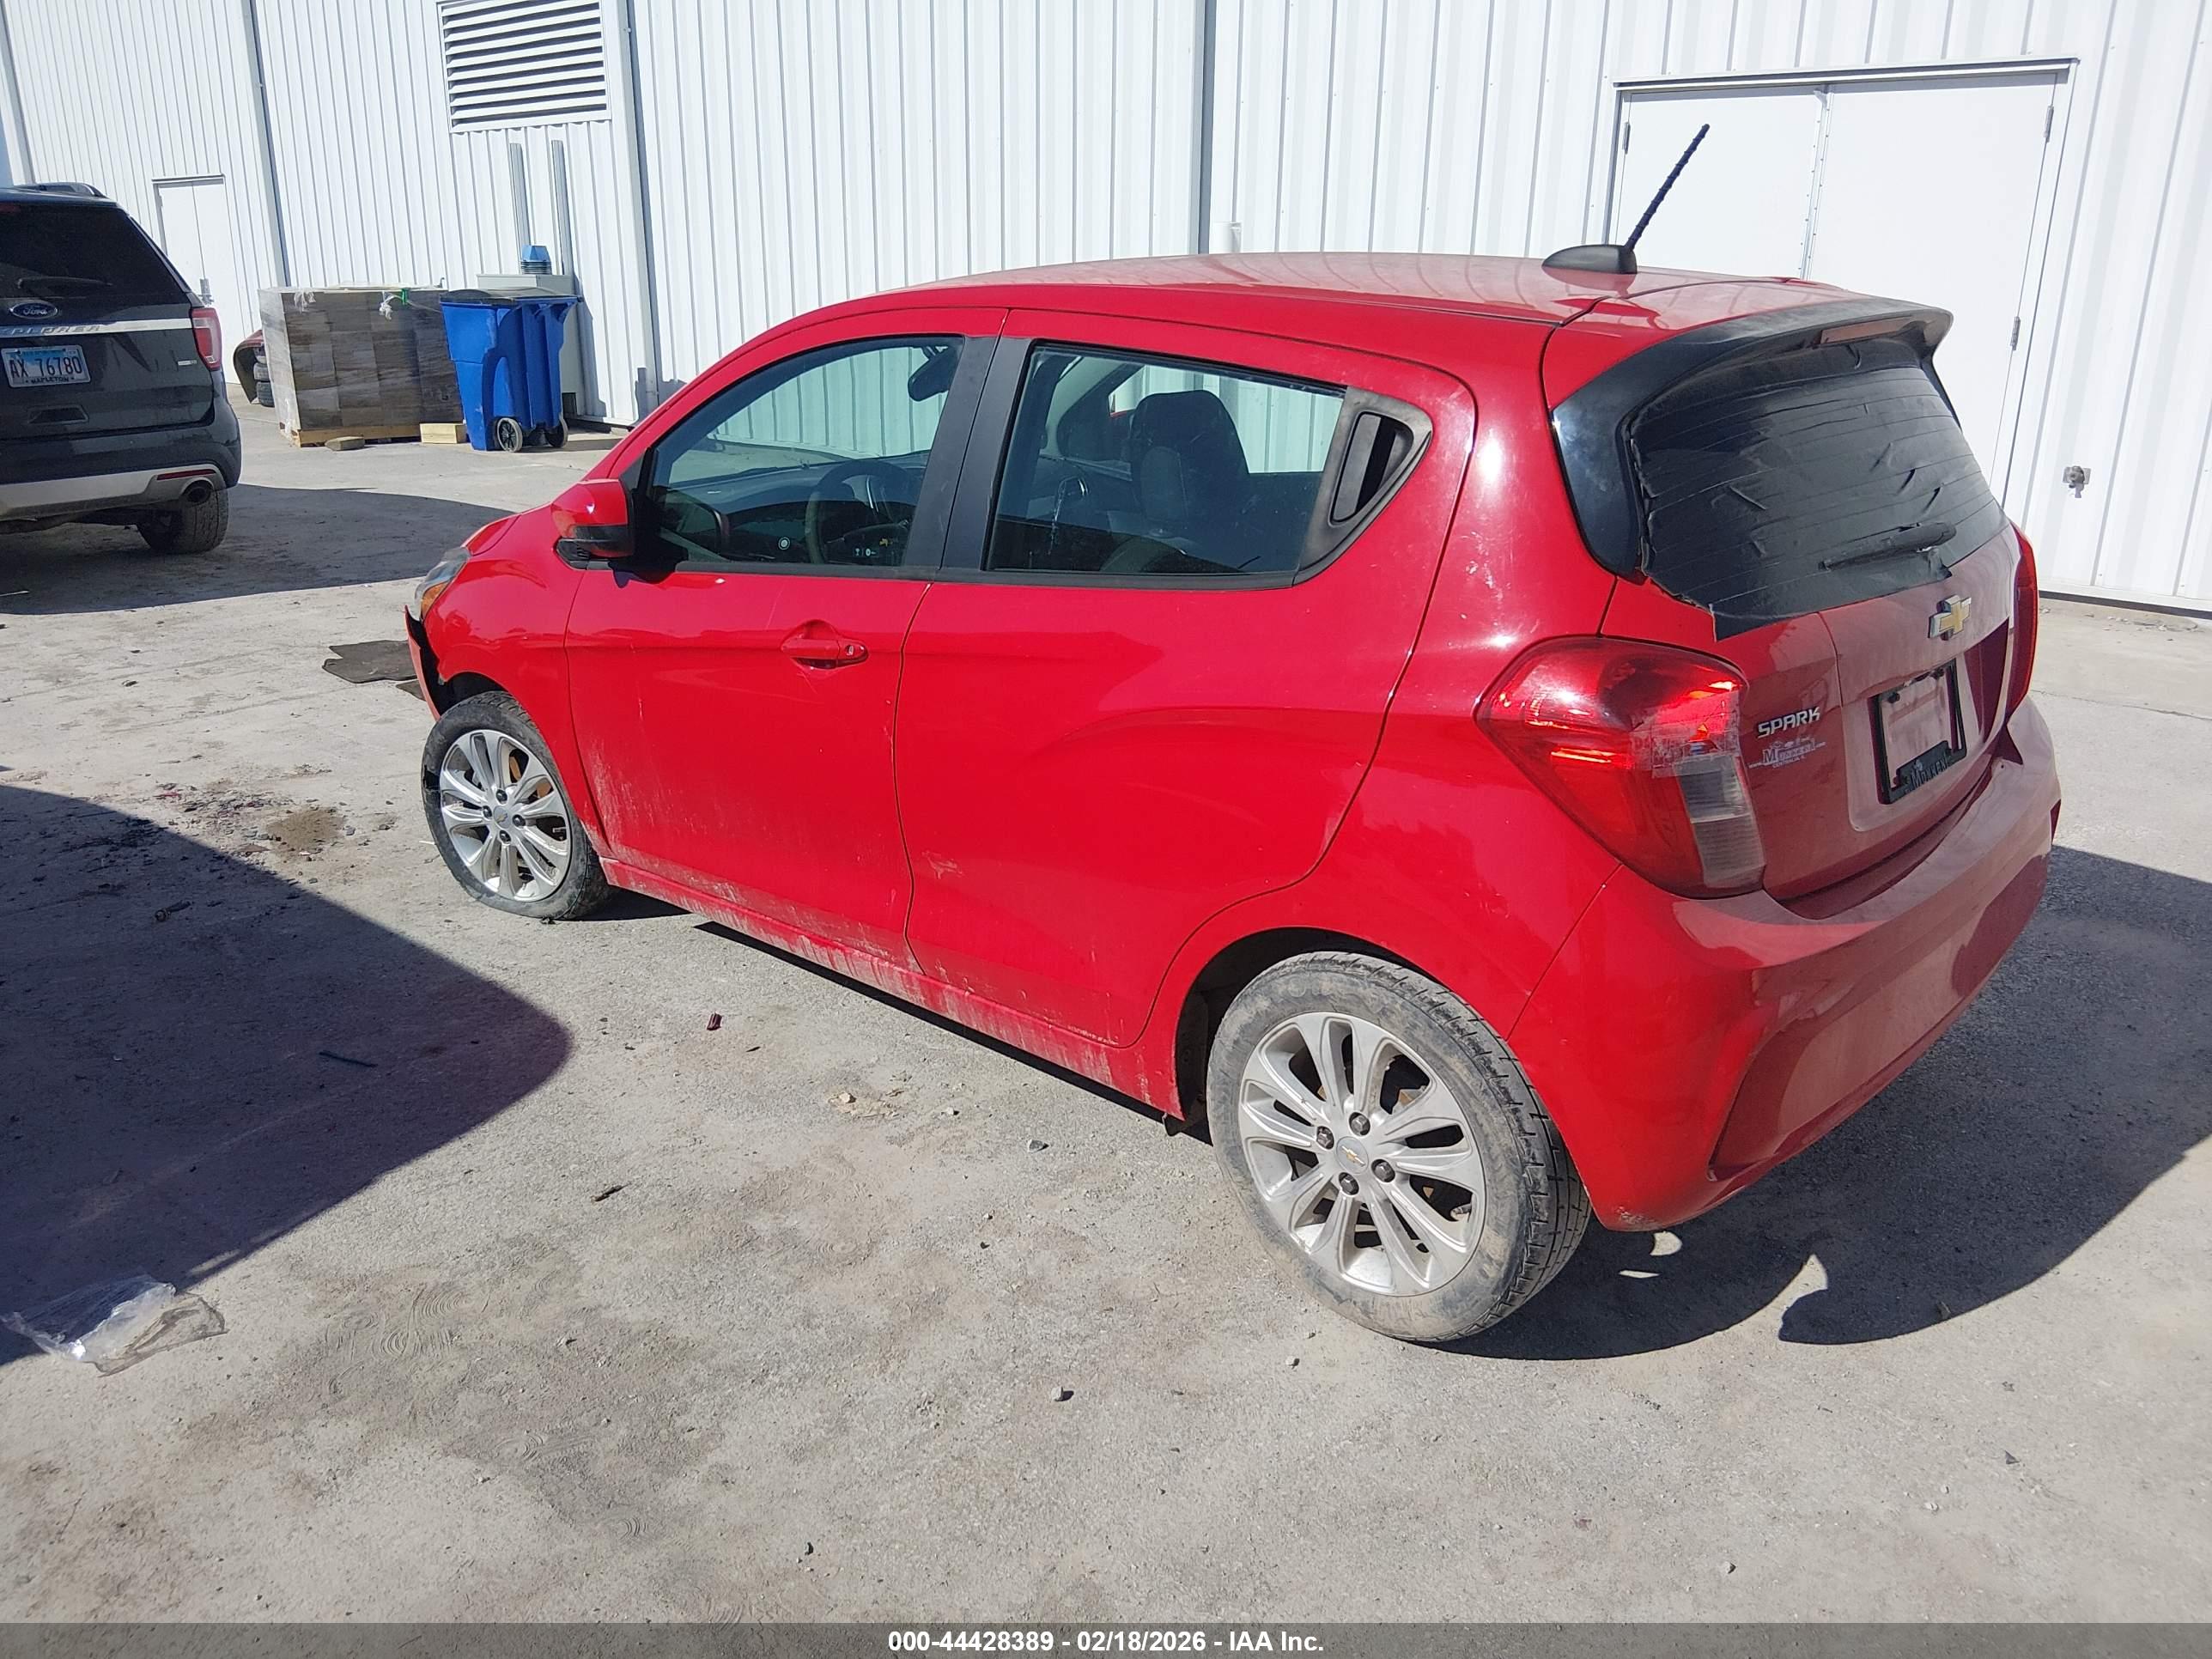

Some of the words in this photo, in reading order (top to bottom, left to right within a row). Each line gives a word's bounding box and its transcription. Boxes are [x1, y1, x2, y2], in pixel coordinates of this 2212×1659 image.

[22, 305, 49, 316] Ford
[9, 357, 29, 379] AX
[34, 356, 82, 377] 76780
[1757, 706, 1820, 739] SPARK
